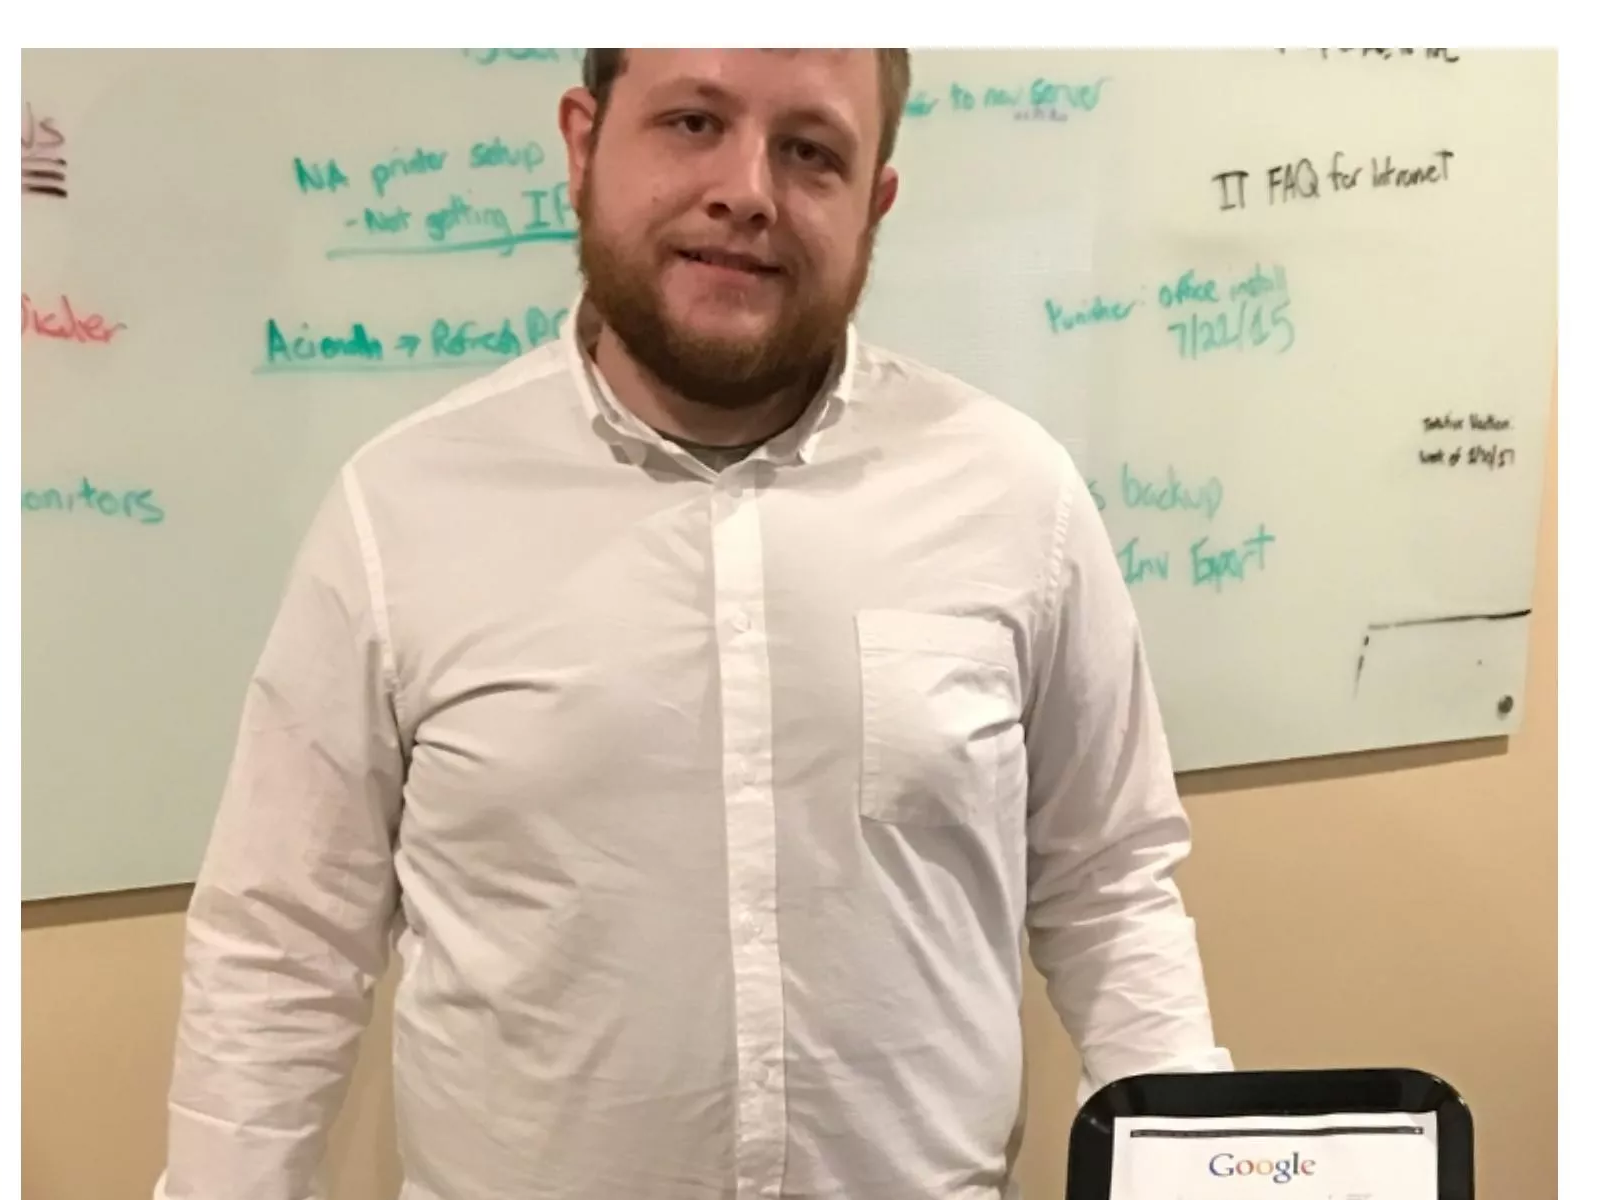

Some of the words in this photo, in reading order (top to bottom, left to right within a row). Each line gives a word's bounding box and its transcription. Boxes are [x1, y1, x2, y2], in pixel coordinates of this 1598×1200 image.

[293, 157, 349, 194] NA
[1211, 170, 1249, 211] IT
[1267, 157, 1320, 206] FAQ
[1327, 150, 1363, 191] for
[1209, 1151, 1316, 1184] Google
